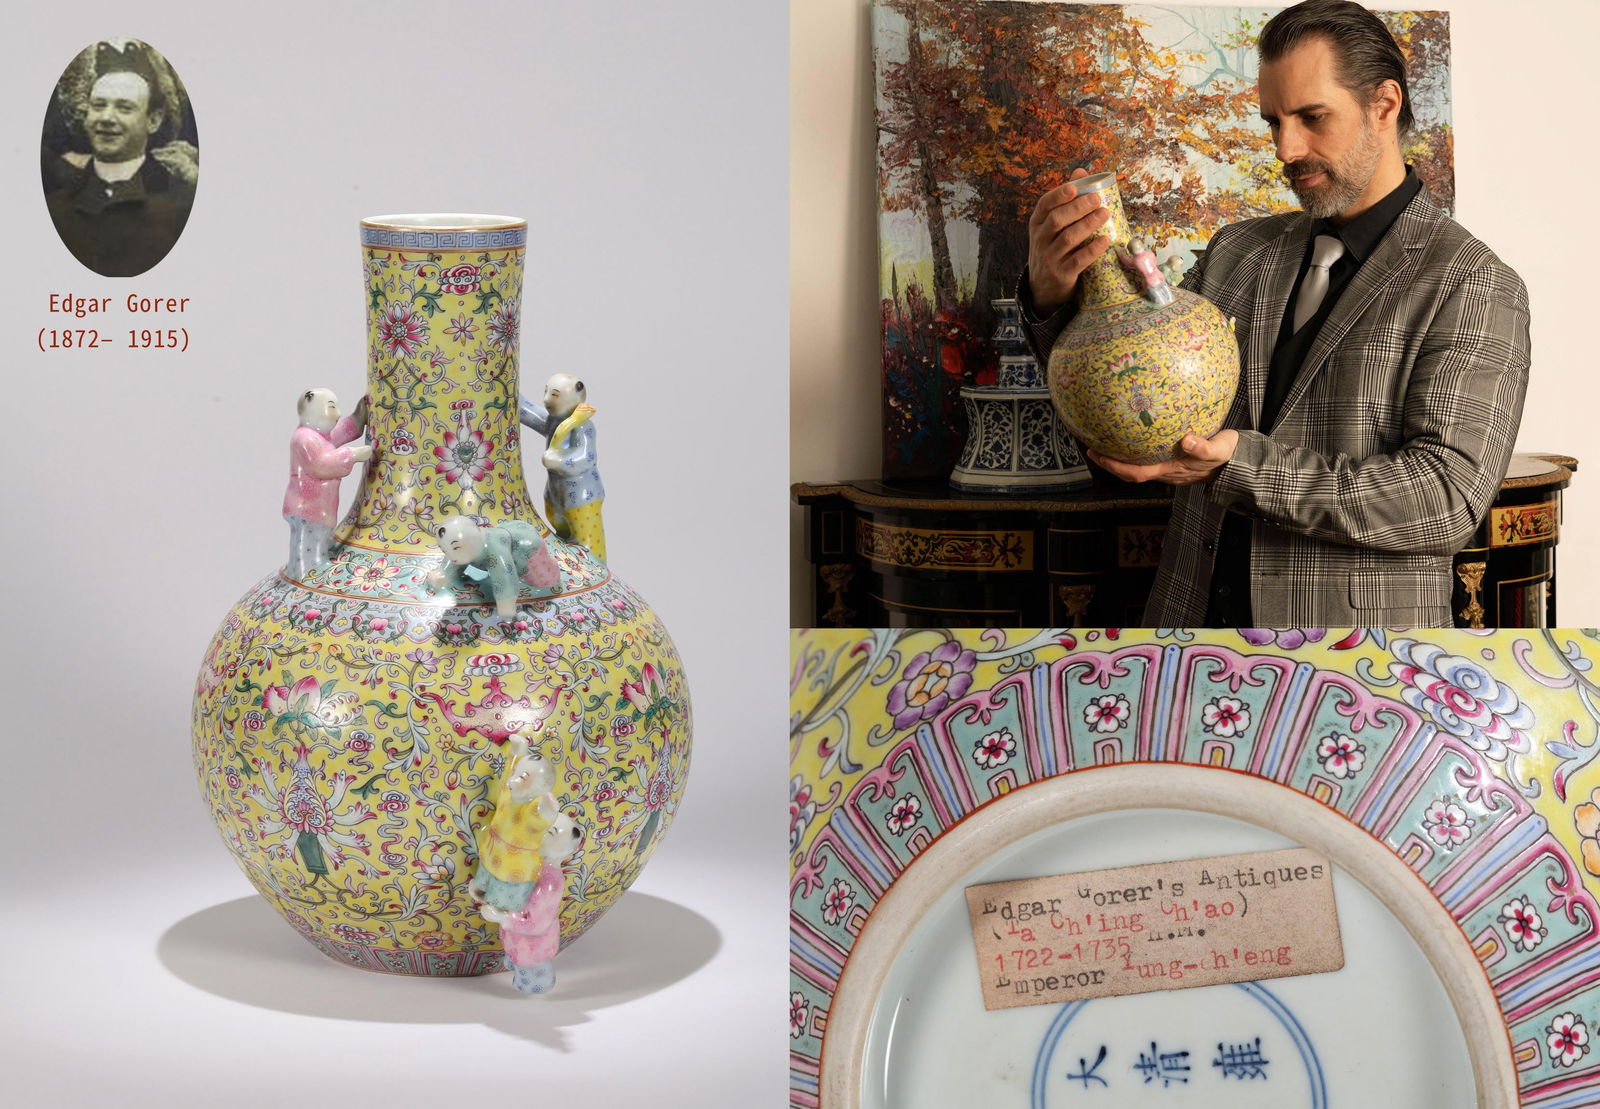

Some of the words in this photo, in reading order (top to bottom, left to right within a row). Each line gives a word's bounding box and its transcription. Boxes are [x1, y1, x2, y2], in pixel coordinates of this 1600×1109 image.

[982, 897, 1061, 921] Edgar
[1077, 879, 1185, 907] Gorer's
[1199, 864, 1323, 889] Antiques
[1050, 912, 1145, 936] Ch'ing
[995, 936, 1132, 972] 1722-1735
[995, 968, 1105, 996] Emperor
